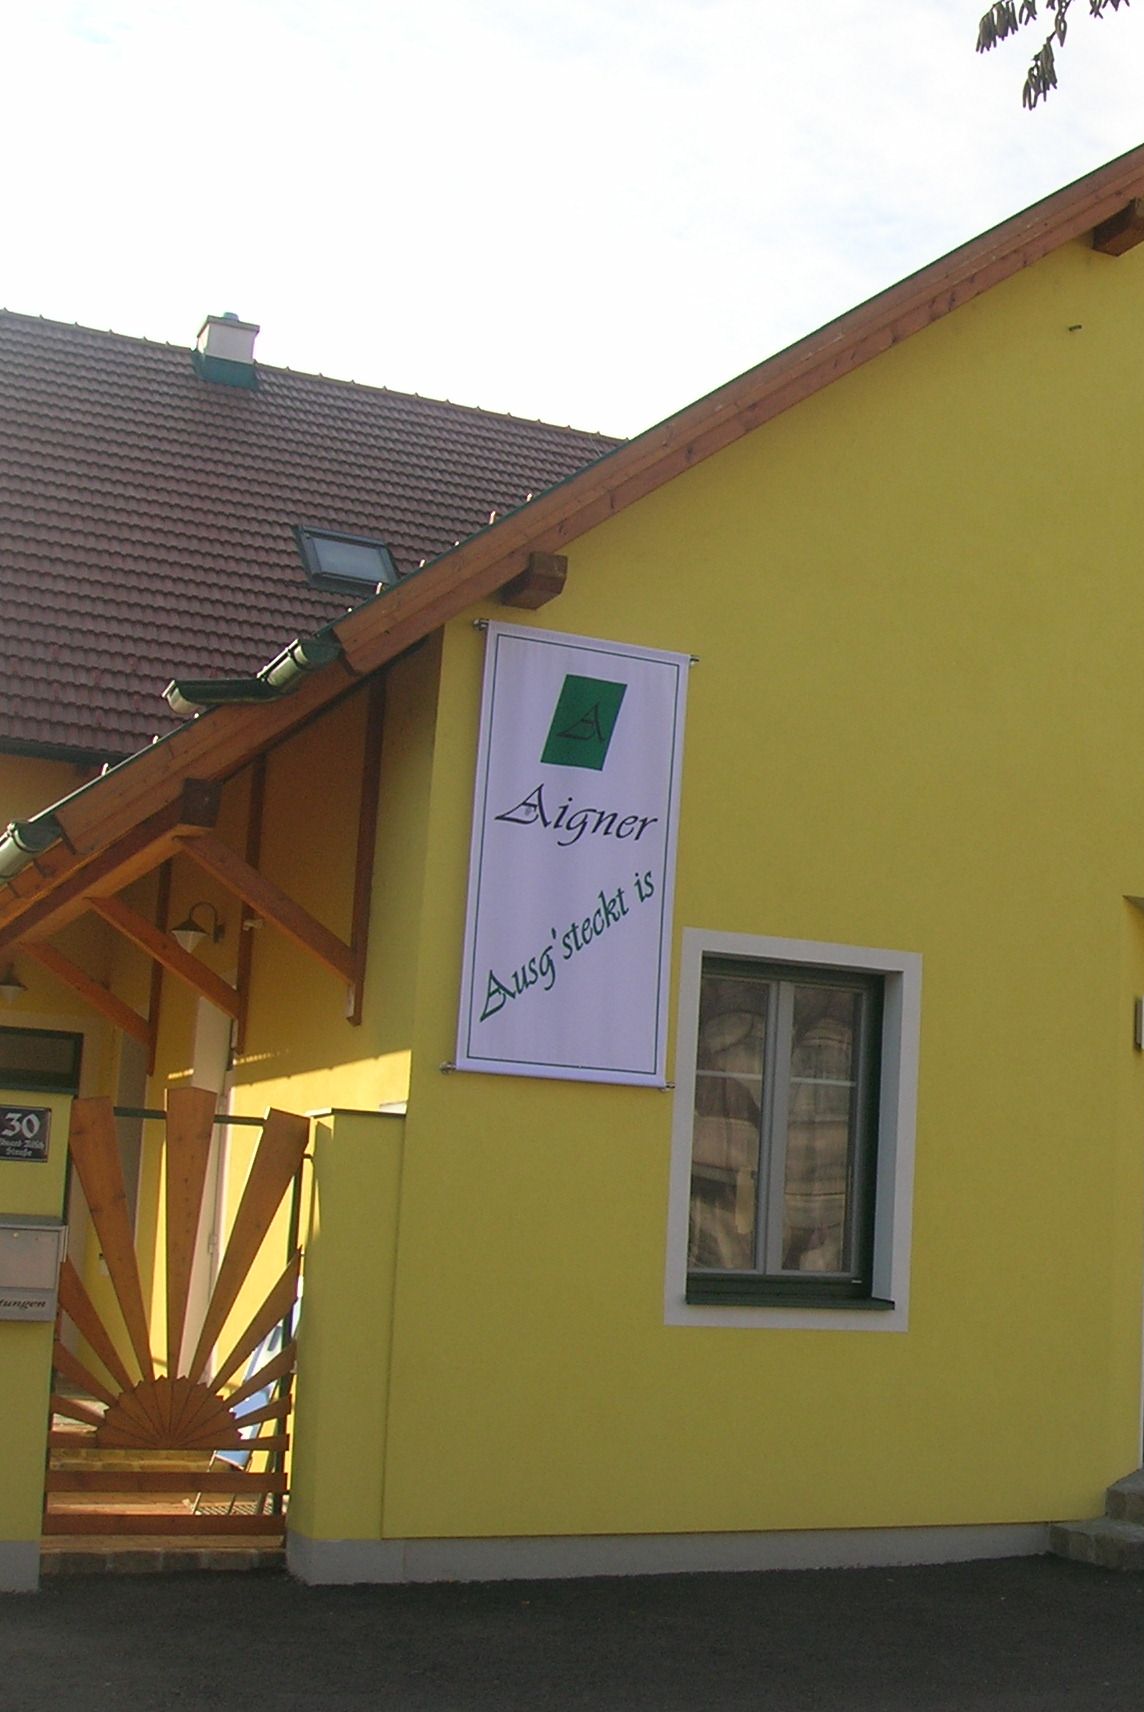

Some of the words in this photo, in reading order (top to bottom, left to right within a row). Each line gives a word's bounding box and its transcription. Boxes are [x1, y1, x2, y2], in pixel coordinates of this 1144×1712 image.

[556, 703, 606, 741] A
[494, 783, 658, 846] Aigner
[480, 888, 630, 1023] Ausg'steckt
[634, 871, 655, 902] is
[1, 1112, 41, 1138] 30
